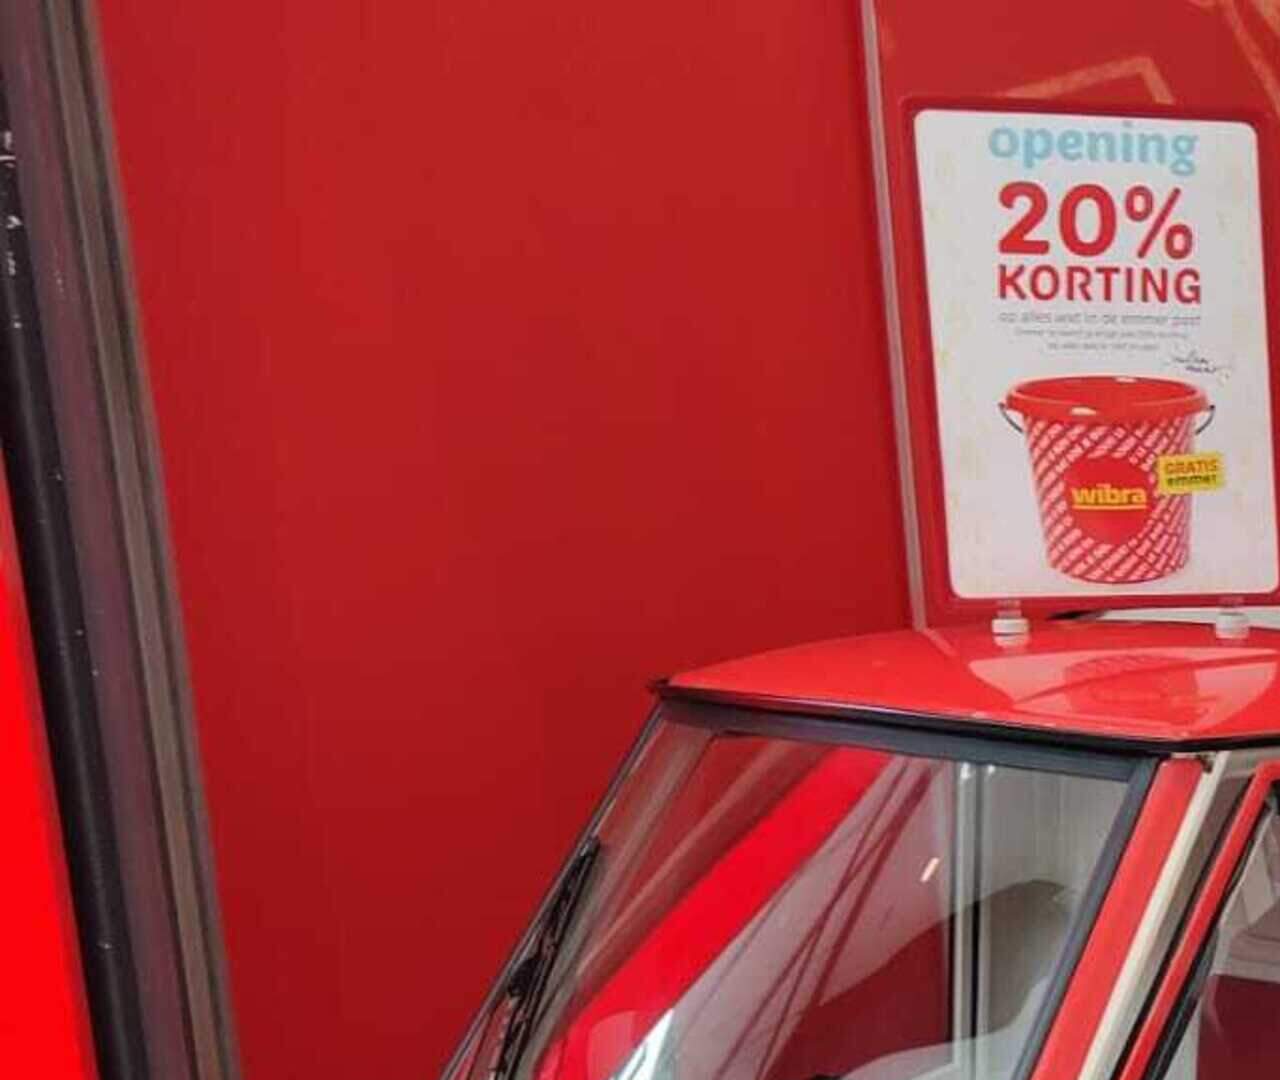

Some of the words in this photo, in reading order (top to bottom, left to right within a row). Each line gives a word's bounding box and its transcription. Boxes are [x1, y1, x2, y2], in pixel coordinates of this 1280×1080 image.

[988, 121, 1200, 177] opening
[998, 181, 1194, 260] 20%
[998, 264, 1202, 304] KORTING
[1164, 458, 1218, 475] GRATIS
[1071, 483, 1148, 505] wibra
